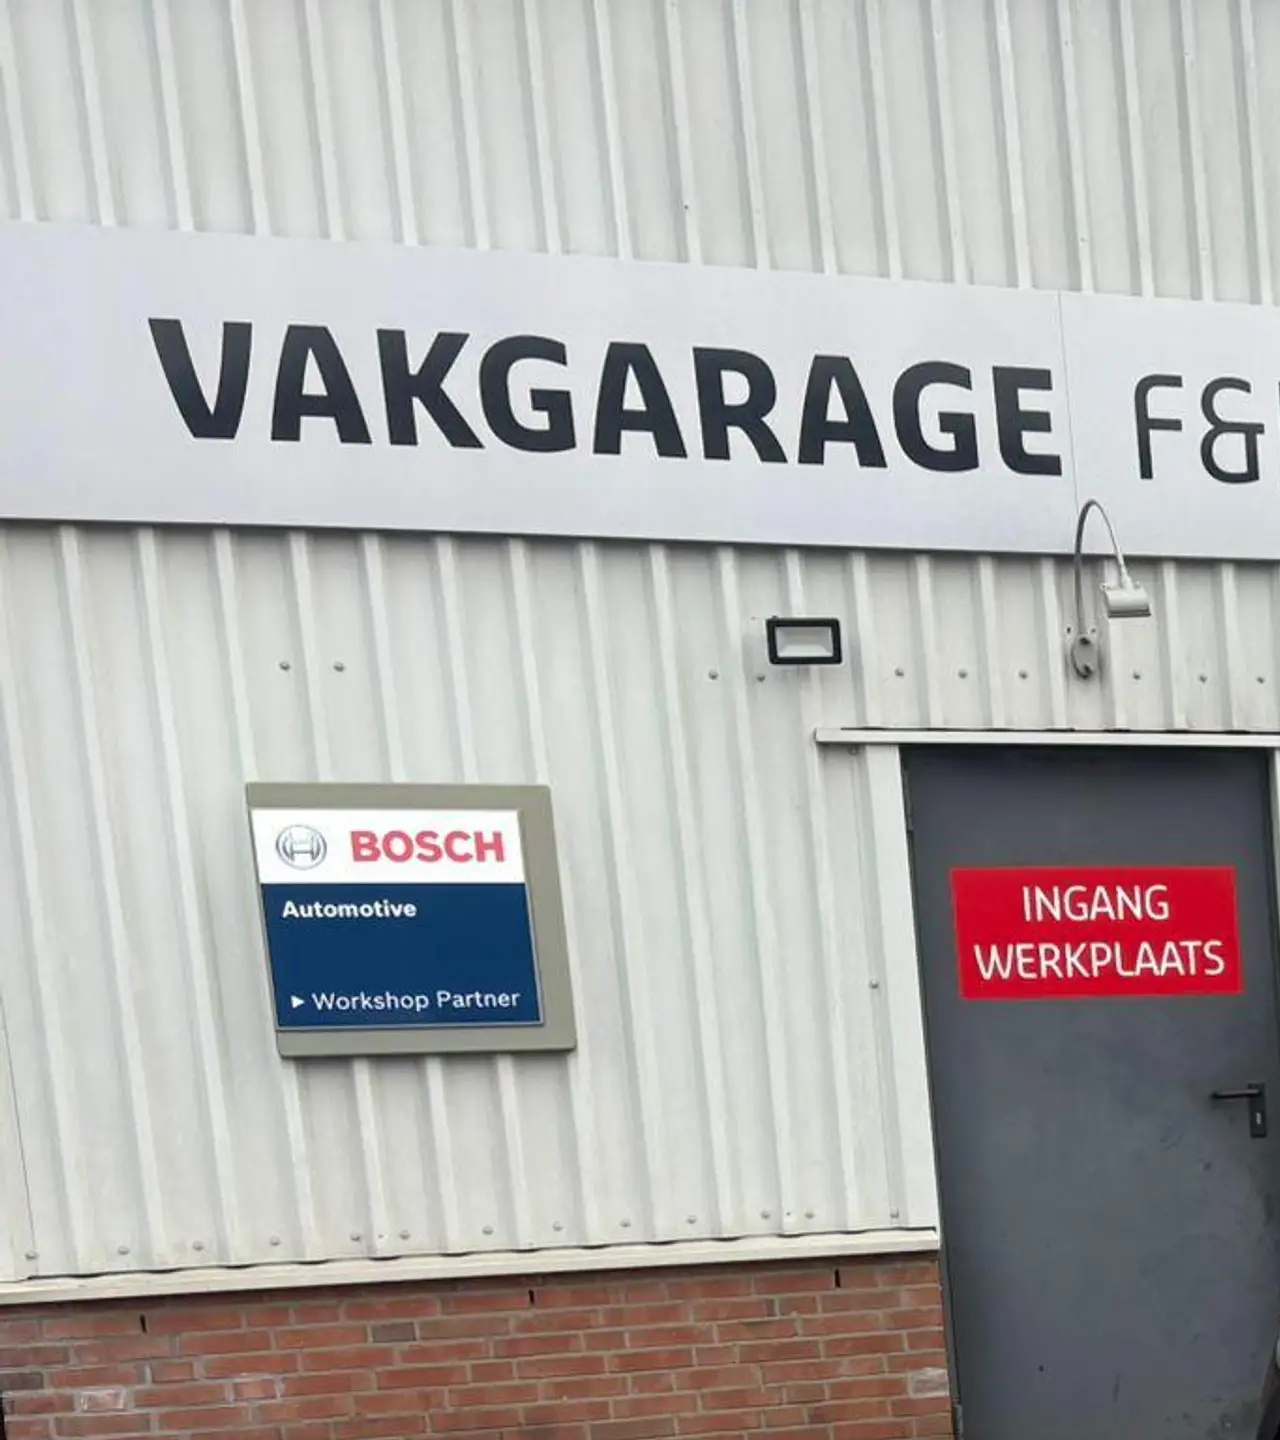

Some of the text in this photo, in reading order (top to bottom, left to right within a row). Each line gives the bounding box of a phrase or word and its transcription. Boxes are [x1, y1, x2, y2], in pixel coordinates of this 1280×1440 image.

[148, 317, 1062, 476] VAKGARAGE
[349, 830, 505, 862] BOSCH
[282, 899, 417, 918] Automotive
[1022, 884, 1170, 922] INGANG
[973, 940, 1226, 980] WERKPLAATS
[311, 990, 520, 1012] Workshop Partner
